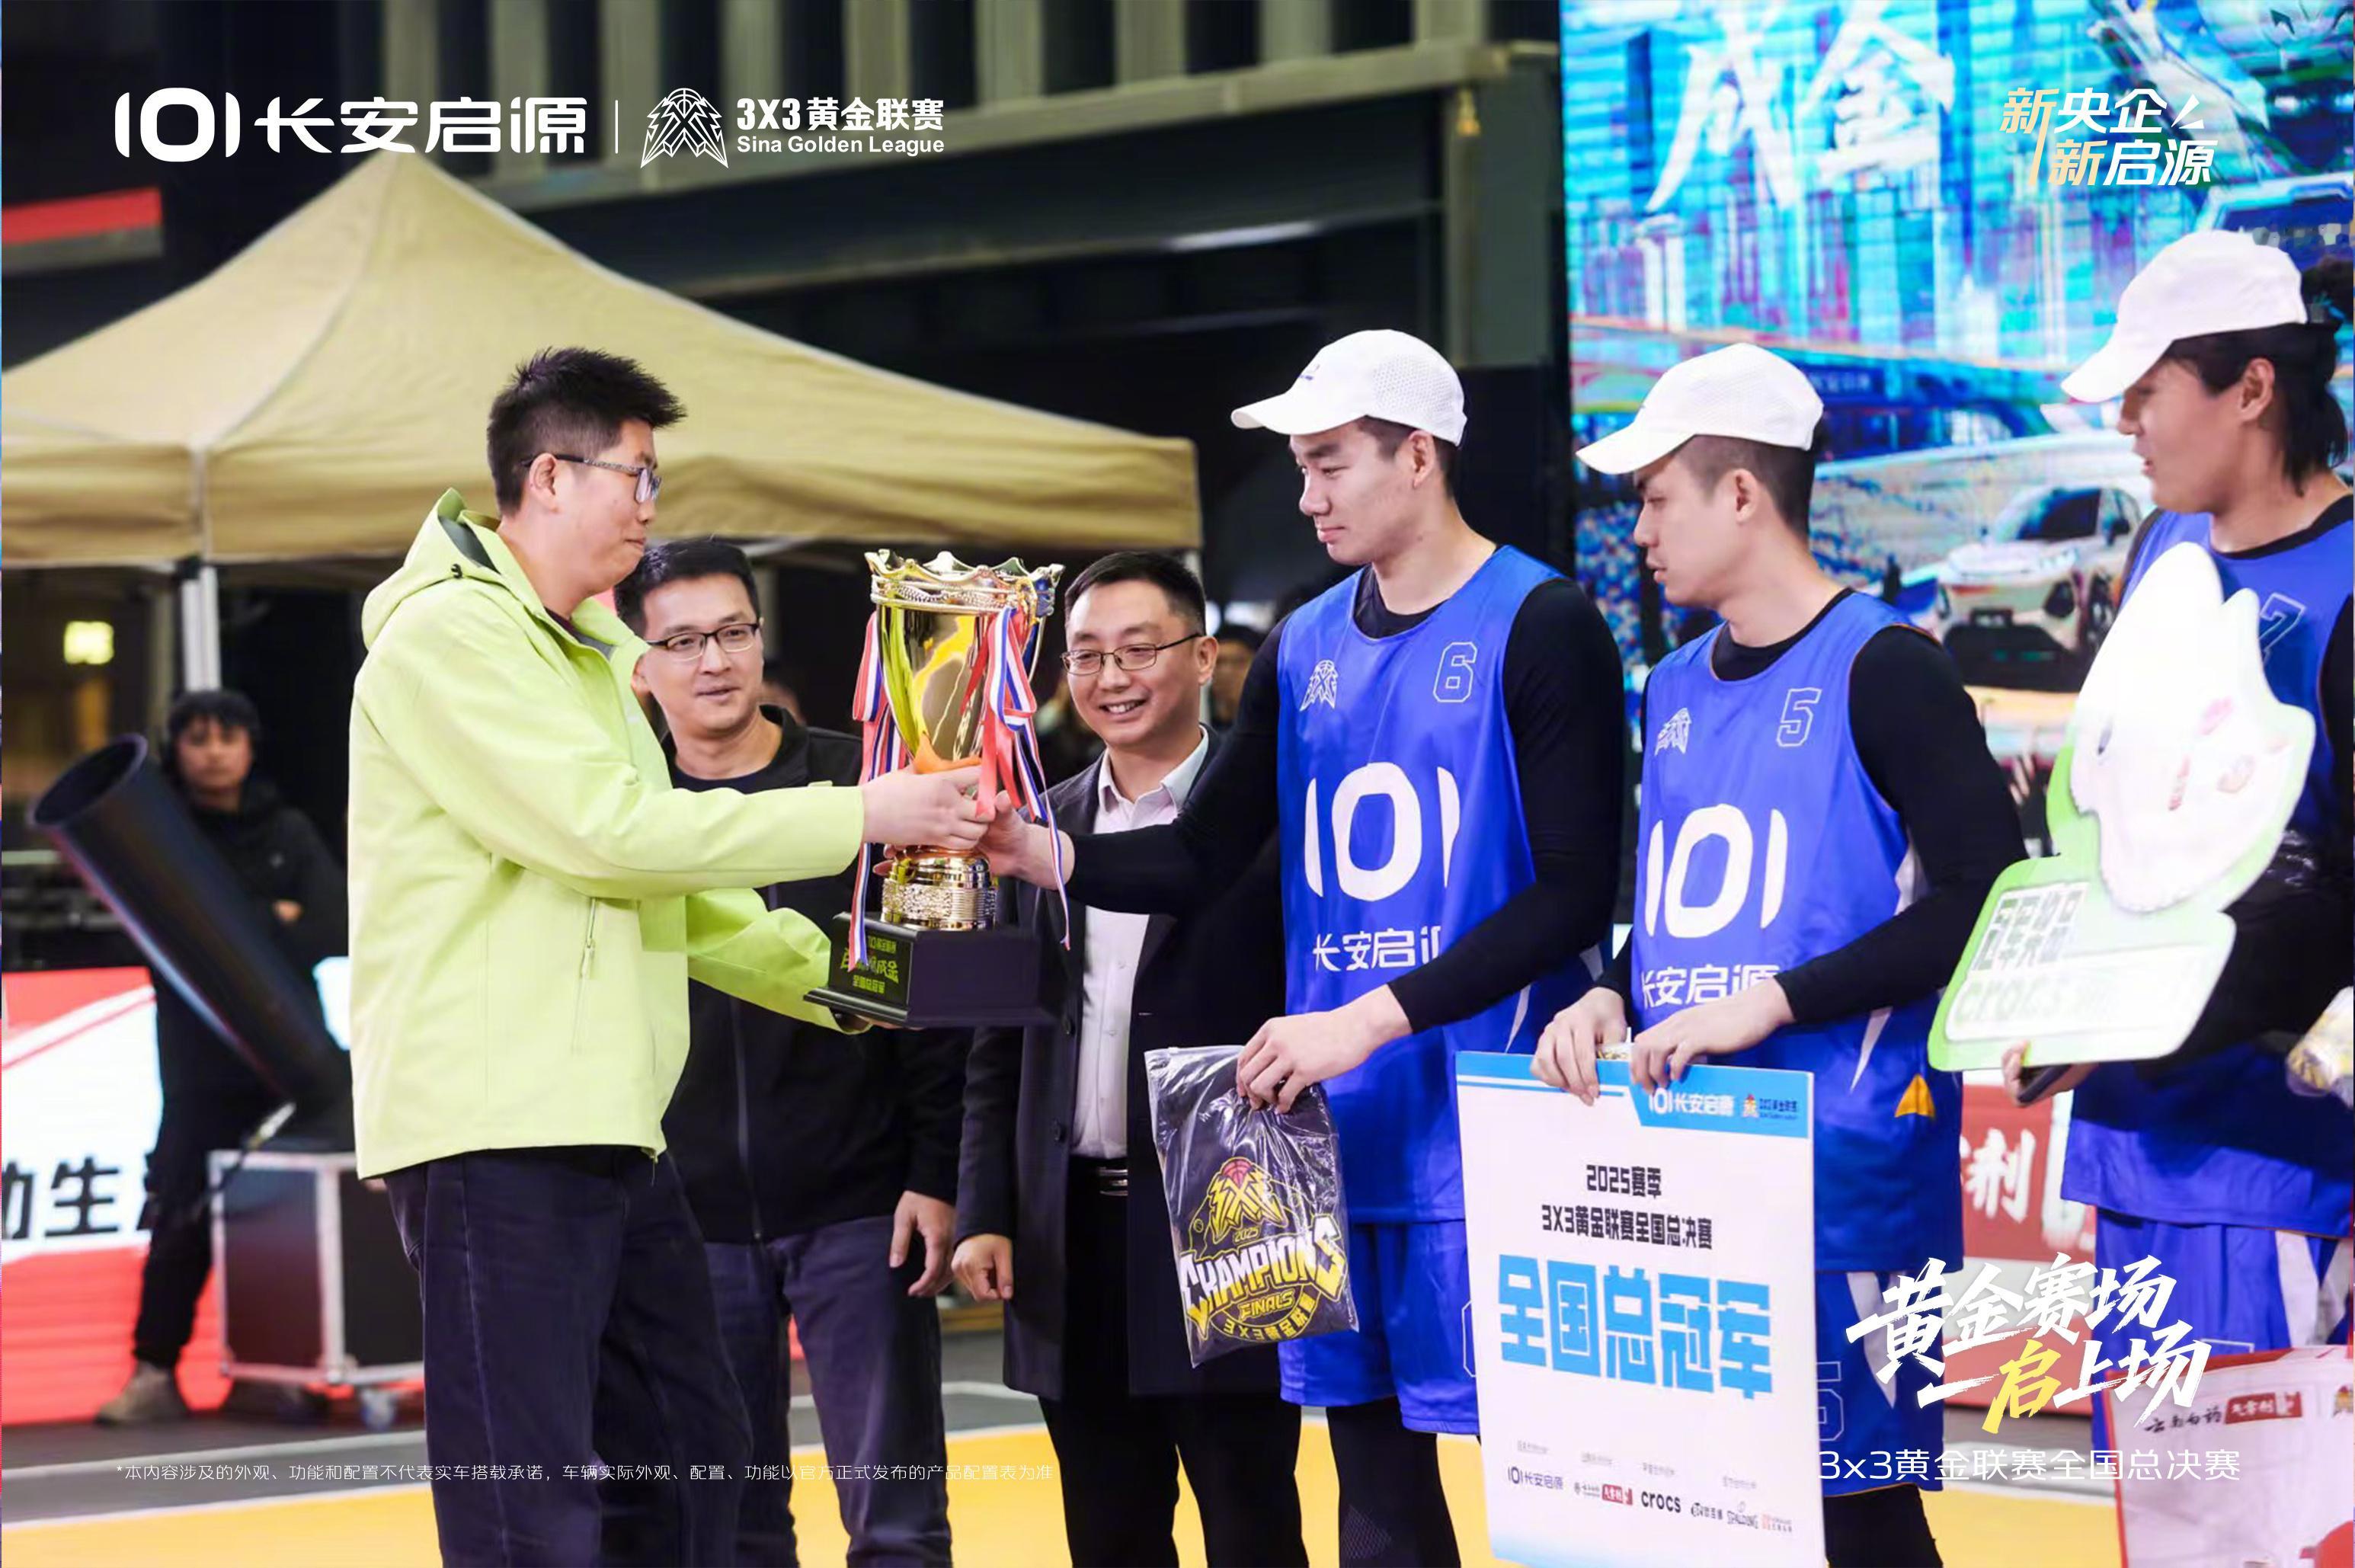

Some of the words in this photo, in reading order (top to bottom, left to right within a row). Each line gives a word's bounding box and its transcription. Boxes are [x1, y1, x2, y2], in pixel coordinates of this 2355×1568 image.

[1433, 642, 1477, 702] 6
[1776, 687, 1822, 747] 5
[1586, 1164, 1662, 1198] 2025赛季
[1233, 1227, 1259, 1243] 2025
[1541, 1204, 1713, 1250] 3X3黄金联赛全国总决赛
[1181, 1214, 1347, 1339] CHAMPIONS
[1239, 1290, 1295, 1322] FINALS
[1498, 1254, 1773, 1400] 全国总冠军
[1641, 1491, 1681, 1514] crocs
